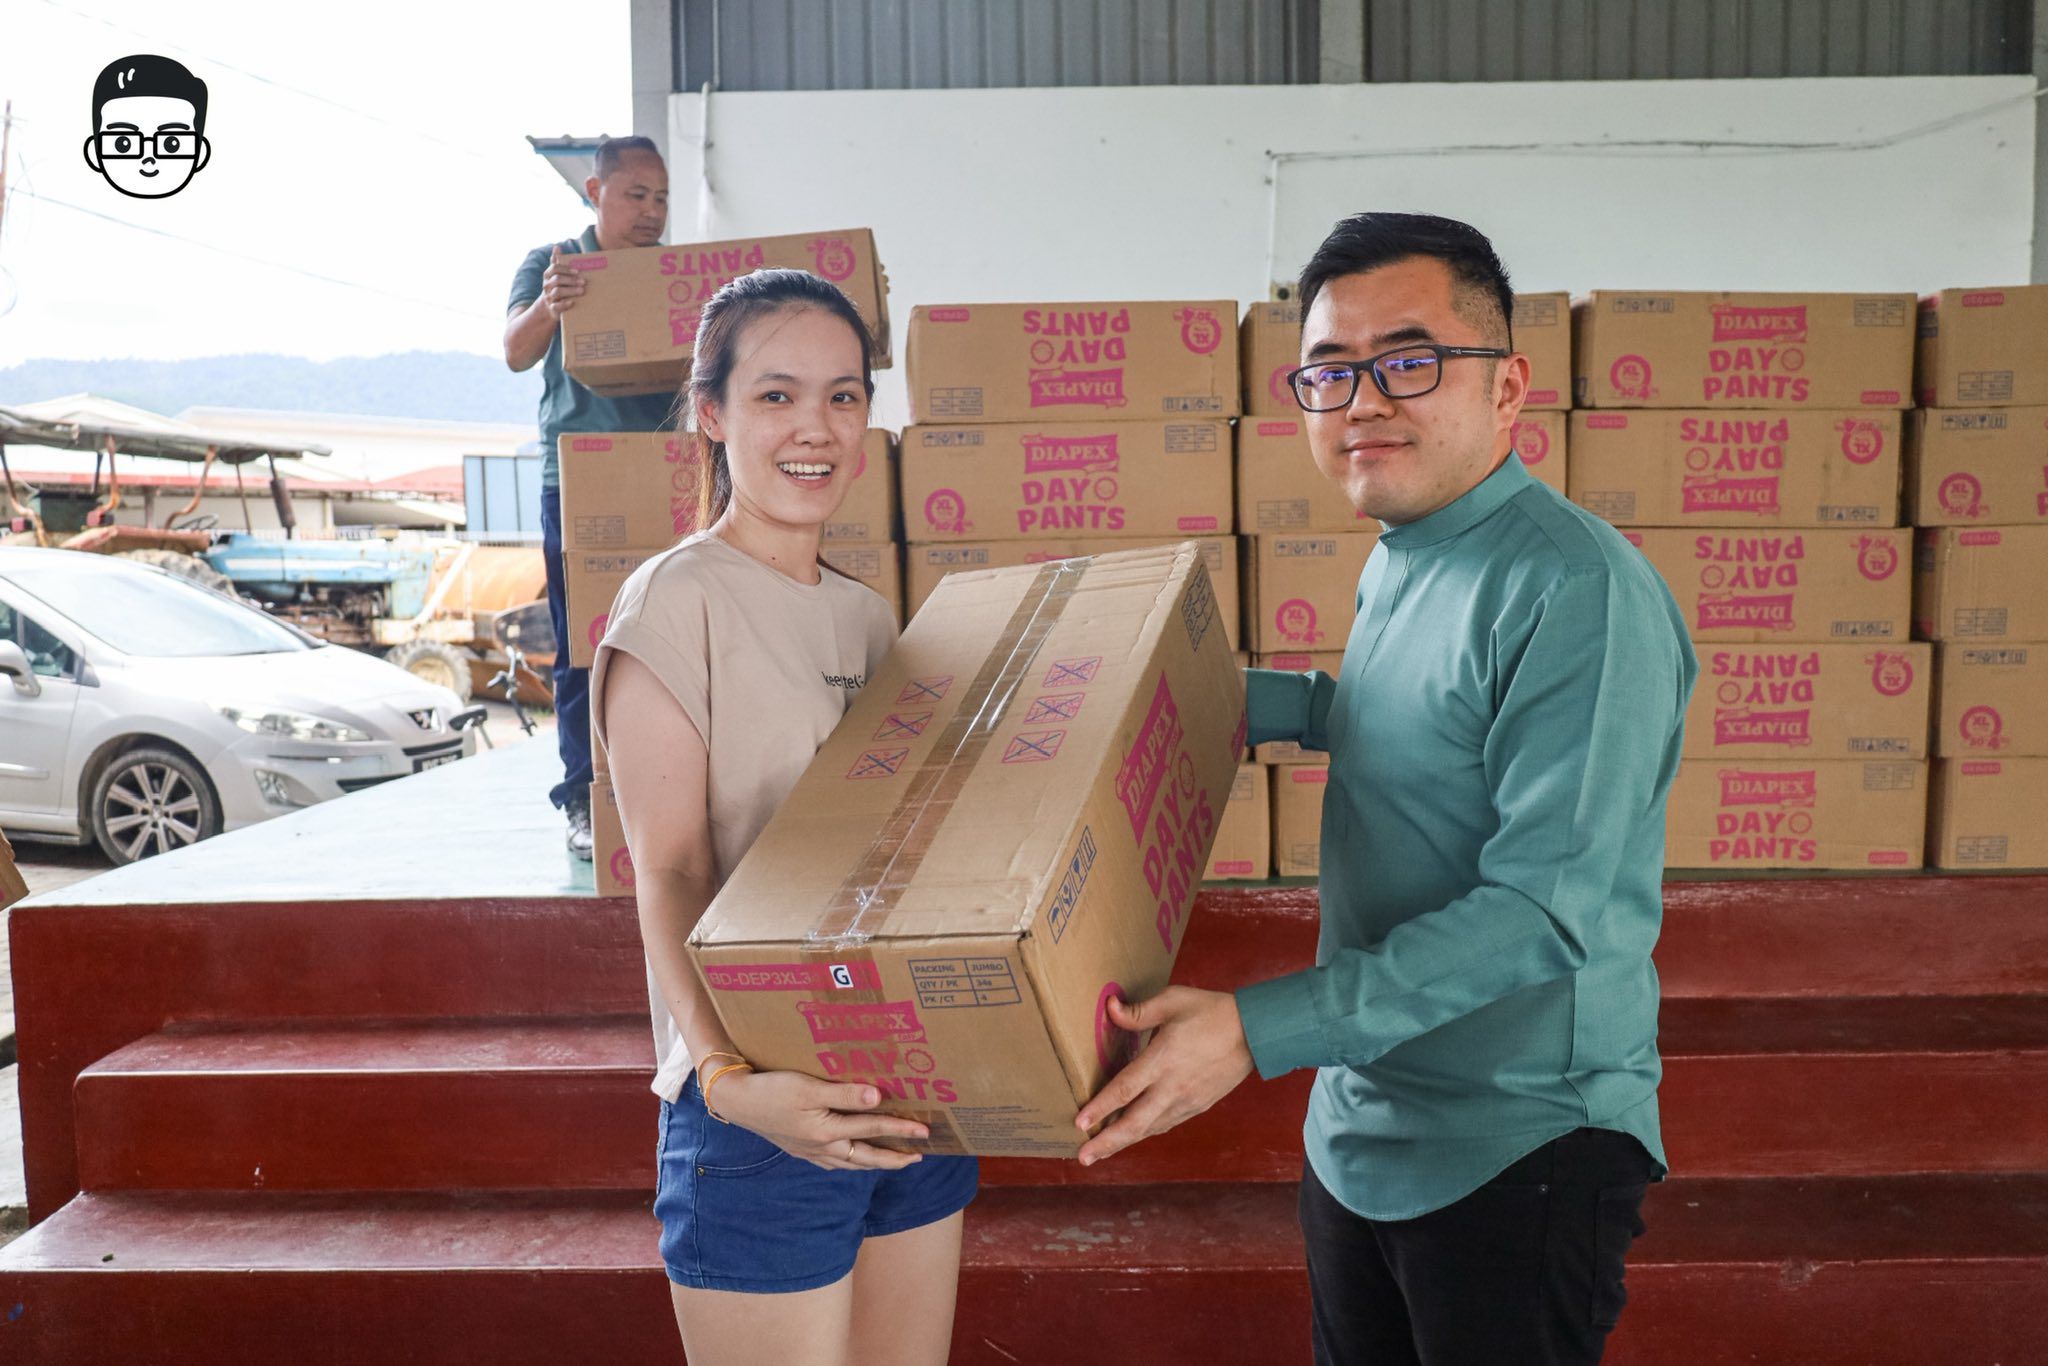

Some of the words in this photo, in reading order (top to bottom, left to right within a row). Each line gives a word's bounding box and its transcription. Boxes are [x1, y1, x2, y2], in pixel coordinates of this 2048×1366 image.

[660, 243, 765, 275] PANTS
[1023, 309, 1130, 336] PANTS
[1719, 314, 1800, 330] DIAPEX
[1058, 336, 1126, 363] DAY
[1708, 346, 1777, 372] DAY
[1041, 381, 1116, 397] DIAPEX
[1703, 375, 1810, 401] PANTS
[1680, 418, 1790, 444] PANTS
[1031, 444, 1109, 461] DIAPEX
[1713, 445, 1783, 471] DAY
[1022, 478, 1090, 505] DAY
[1691, 488, 1771, 503] DIAPEX
[1017, 504, 1125, 533] PANTS
[1695, 536, 1804, 562] PANTS
[1728, 562, 1798, 588] DAY
[1706, 605, 1785, 621] DIAPEX
[1711, 652, 1820, 678] PANTS
[1744, 680, 1814, 704] DAY
[1724, 721, 1802, 737] DIAPEX
[1127, 699, 1173, 816] DIAPEX
[1726, 780, 1807, 795] DIAPEX
[1716, 811, 1786, 835] DAY
[1143, 778, 1182, 901] DAY
[1710, 837, 1817, 861] PANTS
[1156, 788, 1214, 955] PANTS
[833, 967, 851, 986] G
[914, 965, 955, 974] PACKING
[972, 963, 1004, 972] JUMBO
[919, 981, 937, 989] QTY
[812, 1012, 912, 1031] DIAPEX
[816, 1049, 899, 1076] DAY
